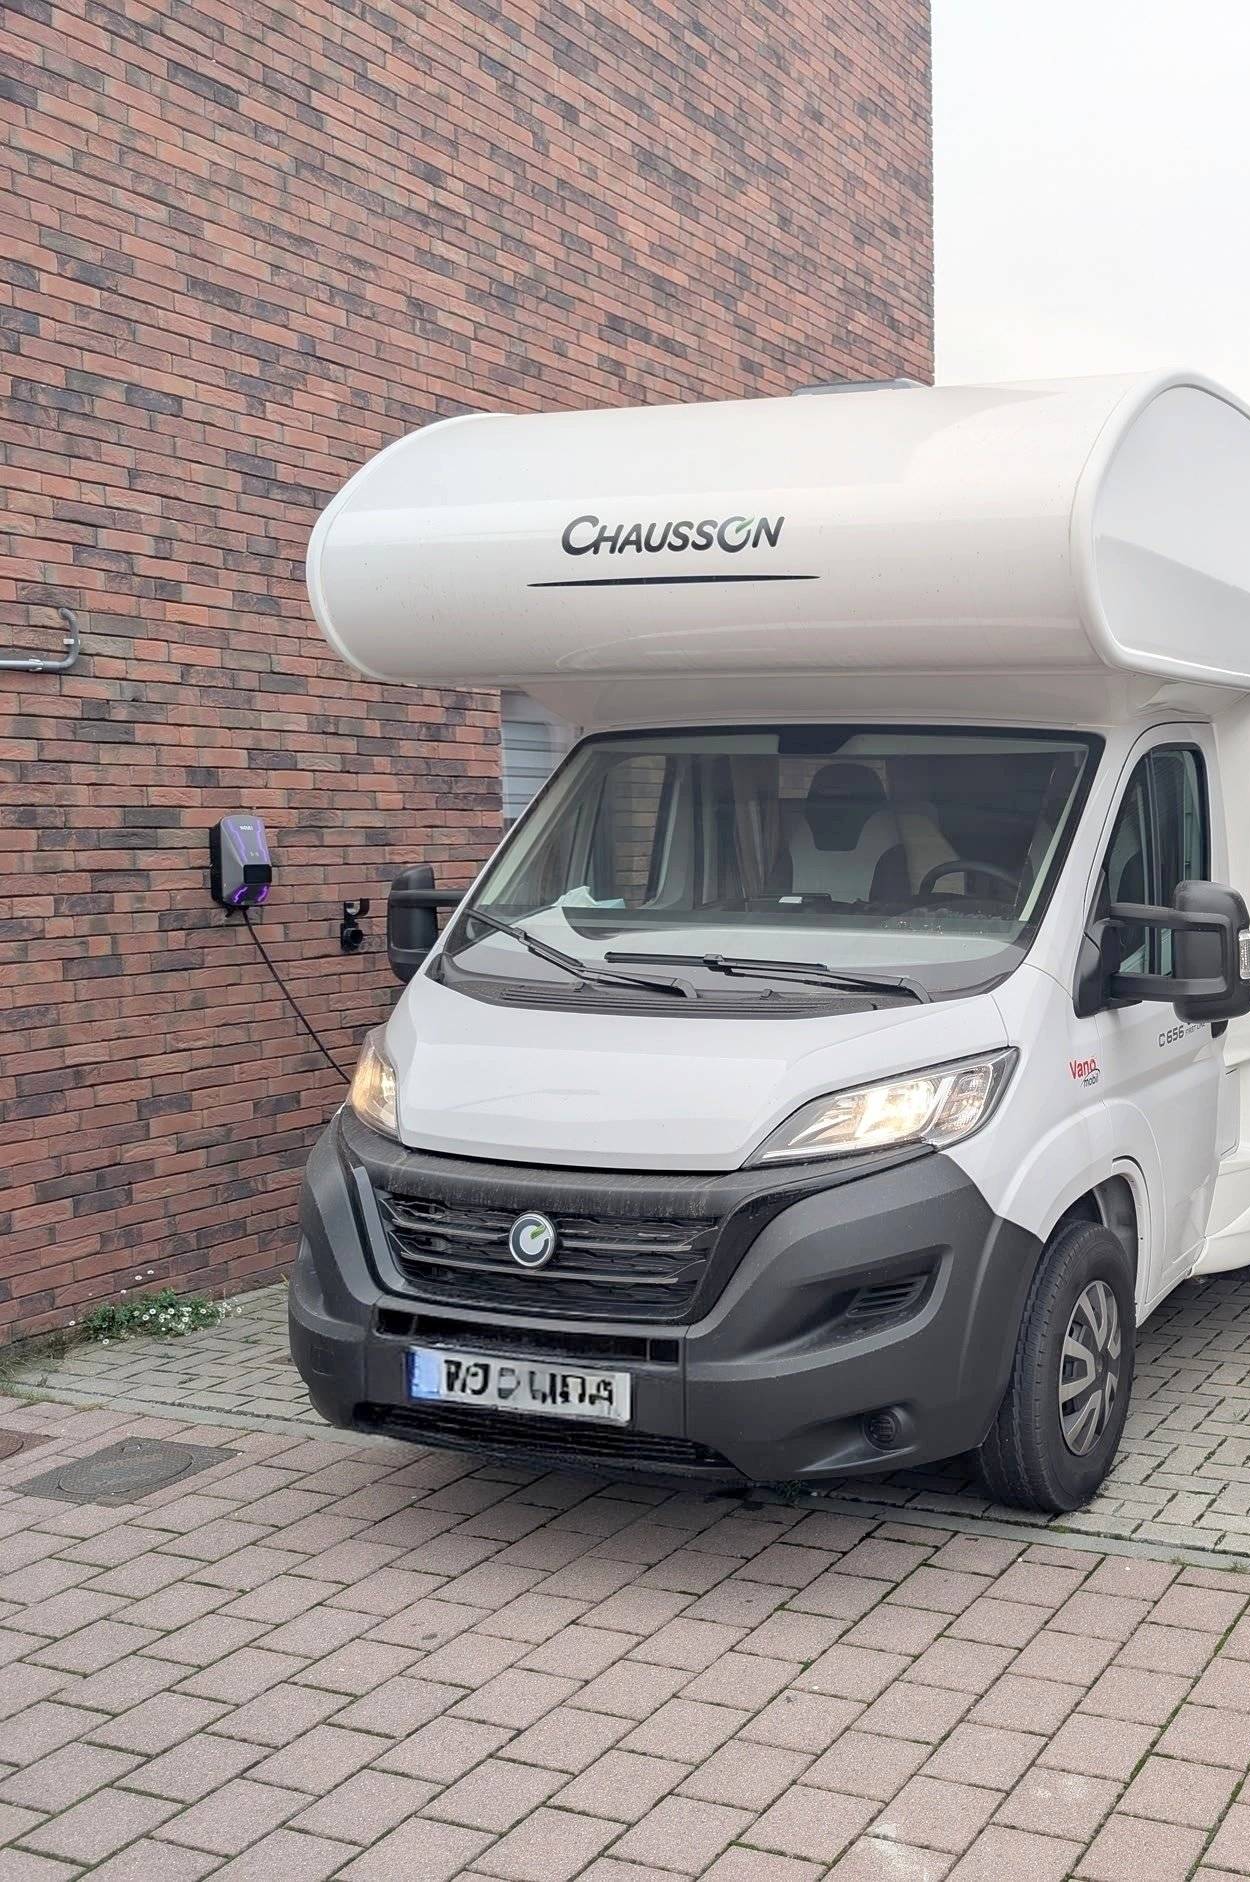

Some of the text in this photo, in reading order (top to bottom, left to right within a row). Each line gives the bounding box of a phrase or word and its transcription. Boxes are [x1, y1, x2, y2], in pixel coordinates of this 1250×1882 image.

[561, 514, 785, 555] CHAUSSON
[1158, 1032, 1166, 1048] C
[1166, 1025, 1185, 1044] 656
[1069, 1058, 1096, 1079] Vano
